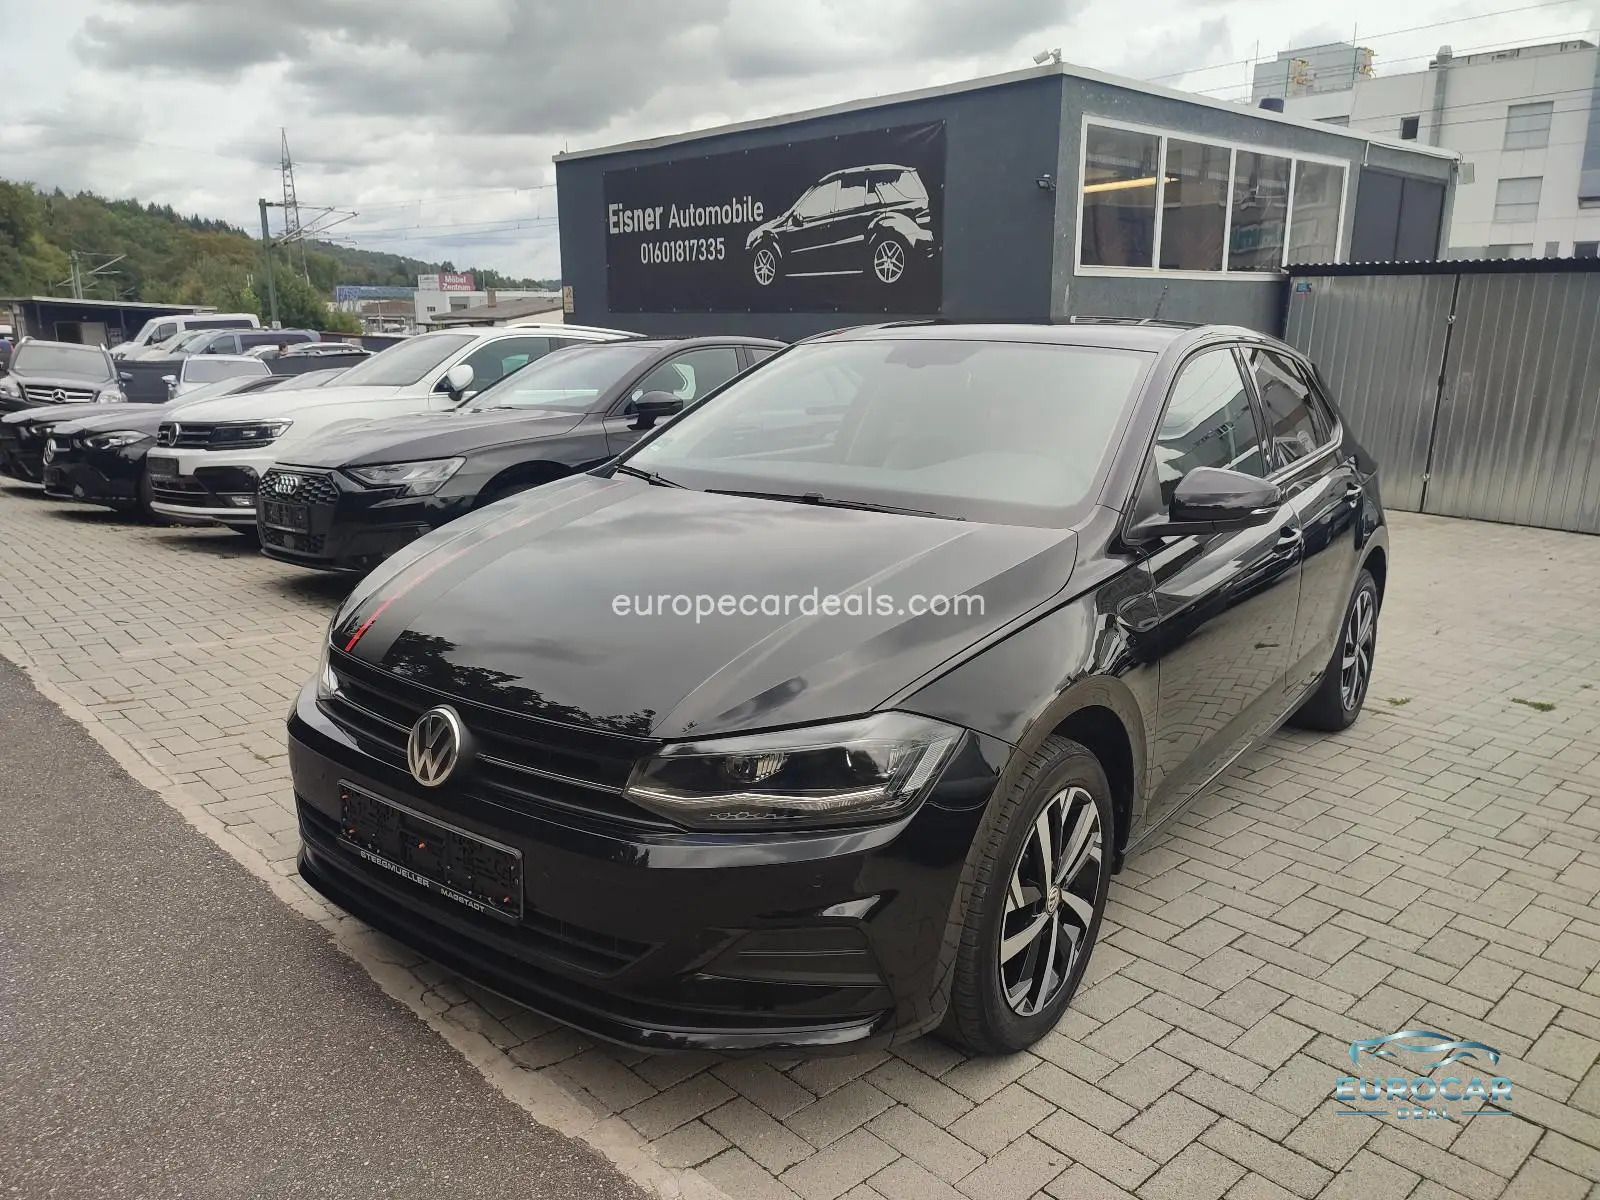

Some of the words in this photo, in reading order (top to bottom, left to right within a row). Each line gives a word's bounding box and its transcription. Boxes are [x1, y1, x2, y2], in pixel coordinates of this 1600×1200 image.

[608, 203, 664, 235] Eisner
[668, 195, 764, 229] Automobile
[640, 237, 725, 264] 01601817335
